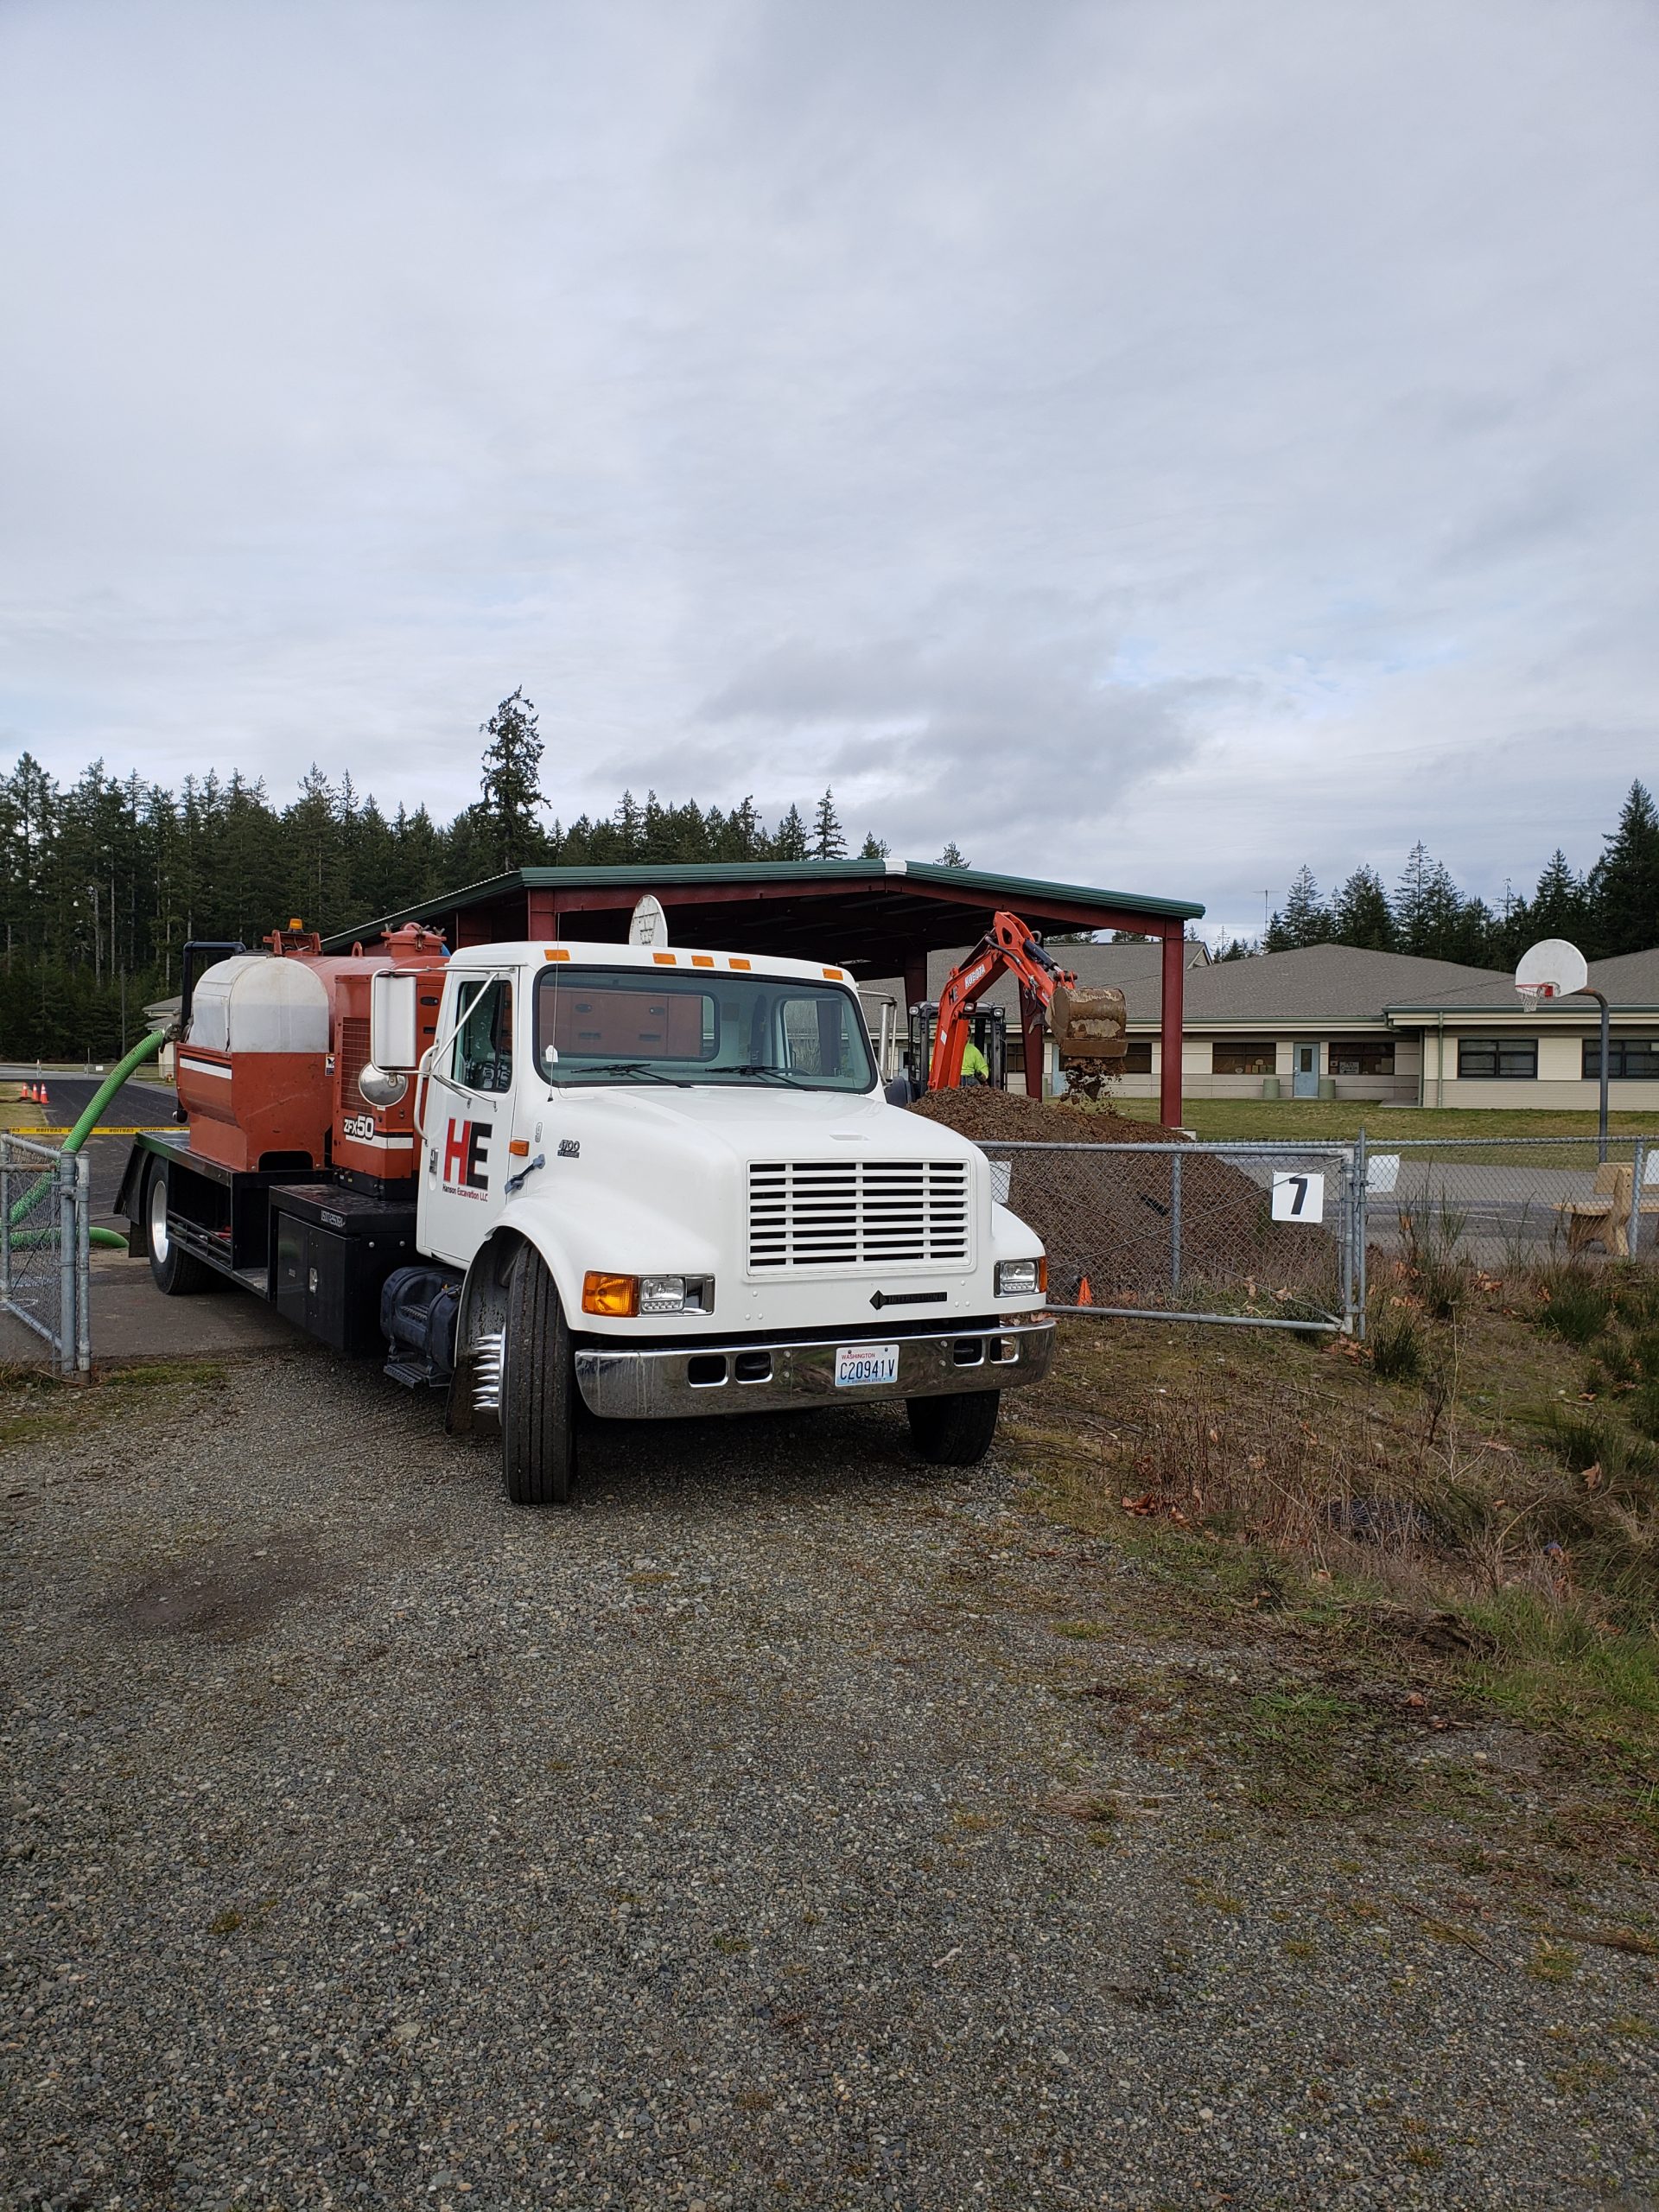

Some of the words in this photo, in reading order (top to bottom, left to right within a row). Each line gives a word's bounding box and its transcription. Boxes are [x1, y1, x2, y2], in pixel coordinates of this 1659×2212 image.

[964, 964, 986, 990] KUBOTA
[343, 1114, 374, 1140] ZFX50
[443, 1117, 493, 1191] HE
[442, 1183, 456, 1195] Hanson
[457, 1186, 480, 1200] Excavation
[480, 1192, 488, 1203] LLC
[1288, 1177, 1308, 1216] 7
[840, 1358, 895, 1380] C20941V
